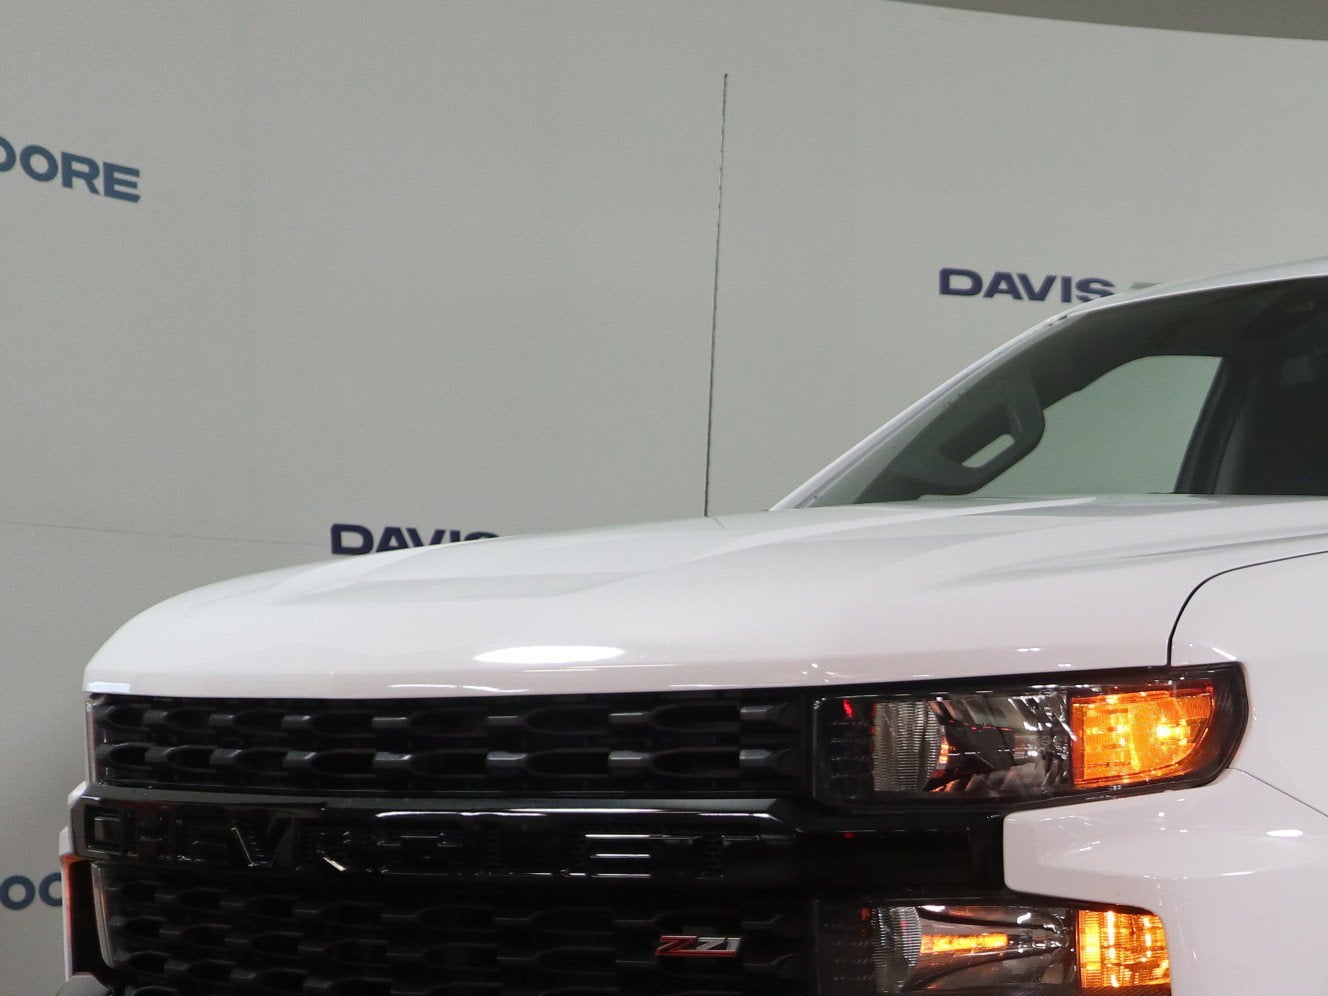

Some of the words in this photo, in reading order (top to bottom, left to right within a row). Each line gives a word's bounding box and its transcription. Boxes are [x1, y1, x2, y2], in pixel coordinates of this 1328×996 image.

[939, 267, 1114, 303] DAVIS
[331, 523, 498, 556] DAV
[655, 935, 742, 958] Z71
